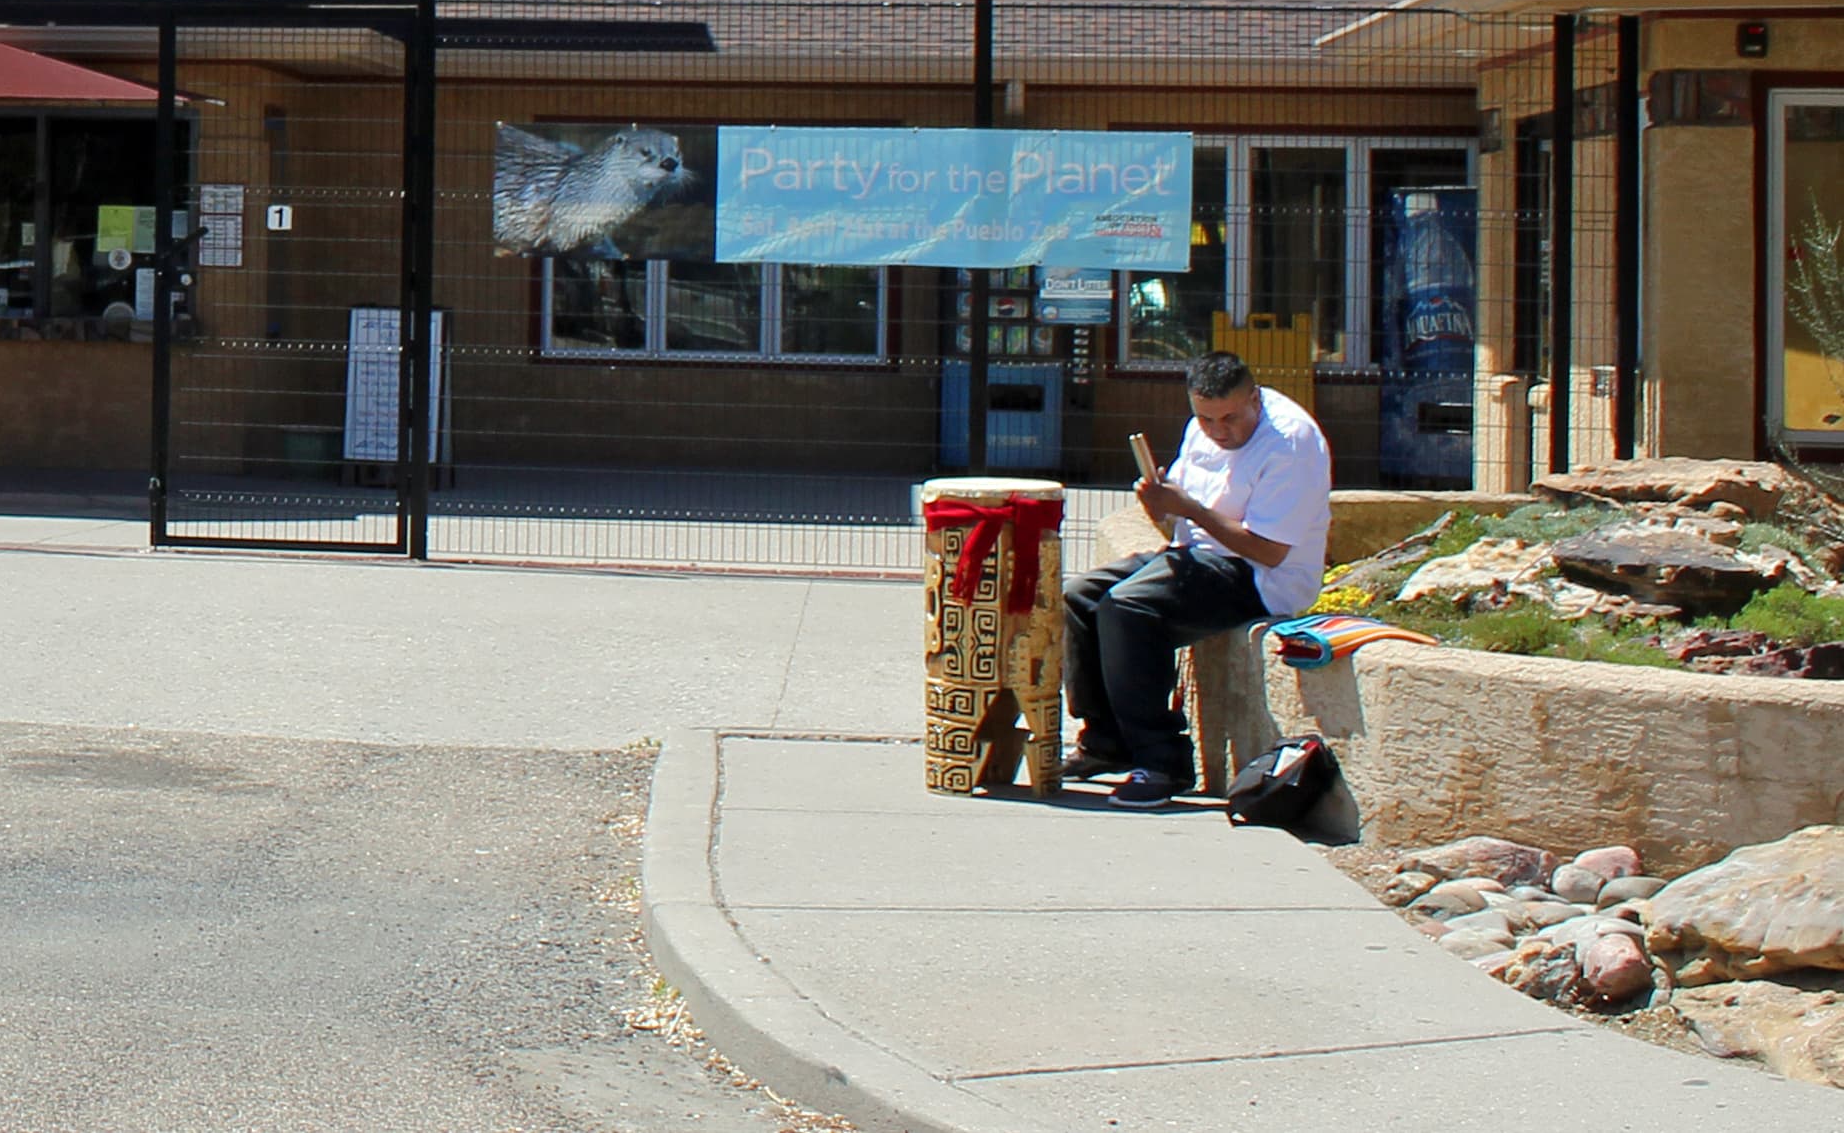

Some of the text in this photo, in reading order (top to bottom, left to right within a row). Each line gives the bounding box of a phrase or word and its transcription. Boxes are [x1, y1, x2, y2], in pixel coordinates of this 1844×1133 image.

[741, 147, 1174, 200] Party for the Planet
[274, 208, 283, 228] 1
[955, 217, 1023, 242] Pueblo
